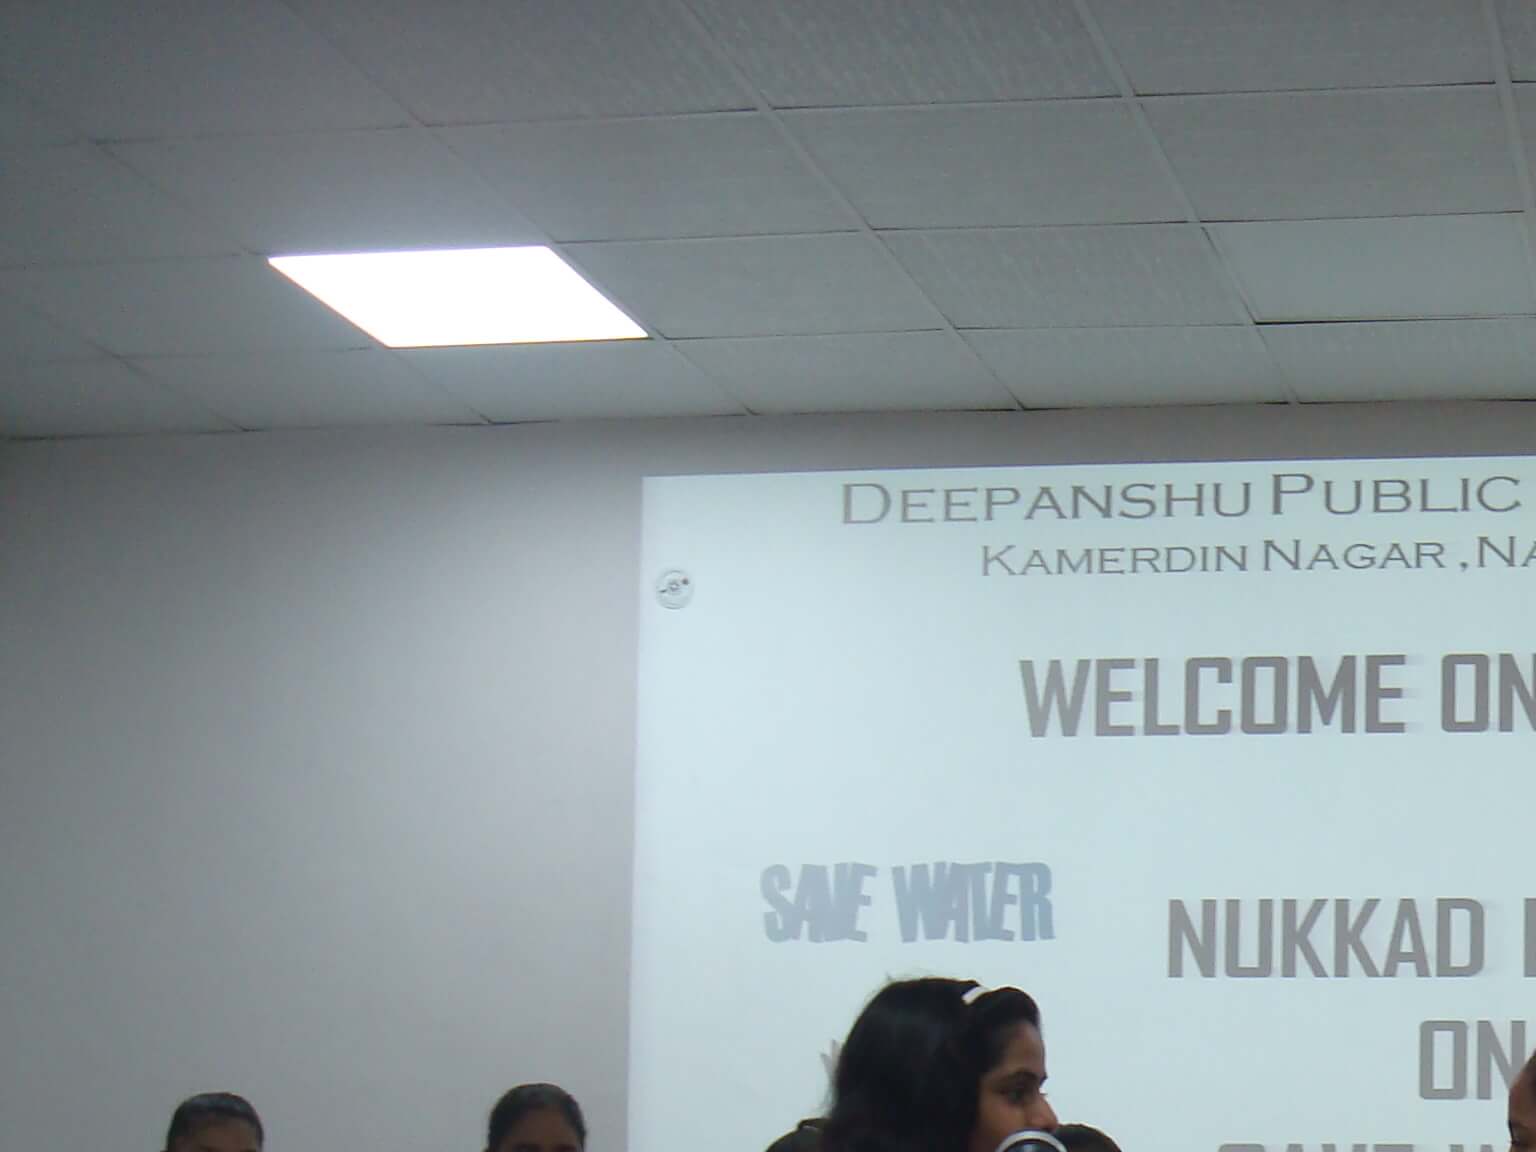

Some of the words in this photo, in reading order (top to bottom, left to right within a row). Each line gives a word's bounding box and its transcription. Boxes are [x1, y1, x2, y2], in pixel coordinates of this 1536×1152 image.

[841, 480, 1251, 525] DEEPANSHU
[982, 545, 1249, 577] KAMERDIN
[1019, 655, 1406, 738] WELCOME
[760, 861, 878, 943] SAVE
[891, 861, 1056, 943] WATER
[1167, 898, 1486, 978] NUKKAD
[1418, 1020, 1528, 1100] ON
